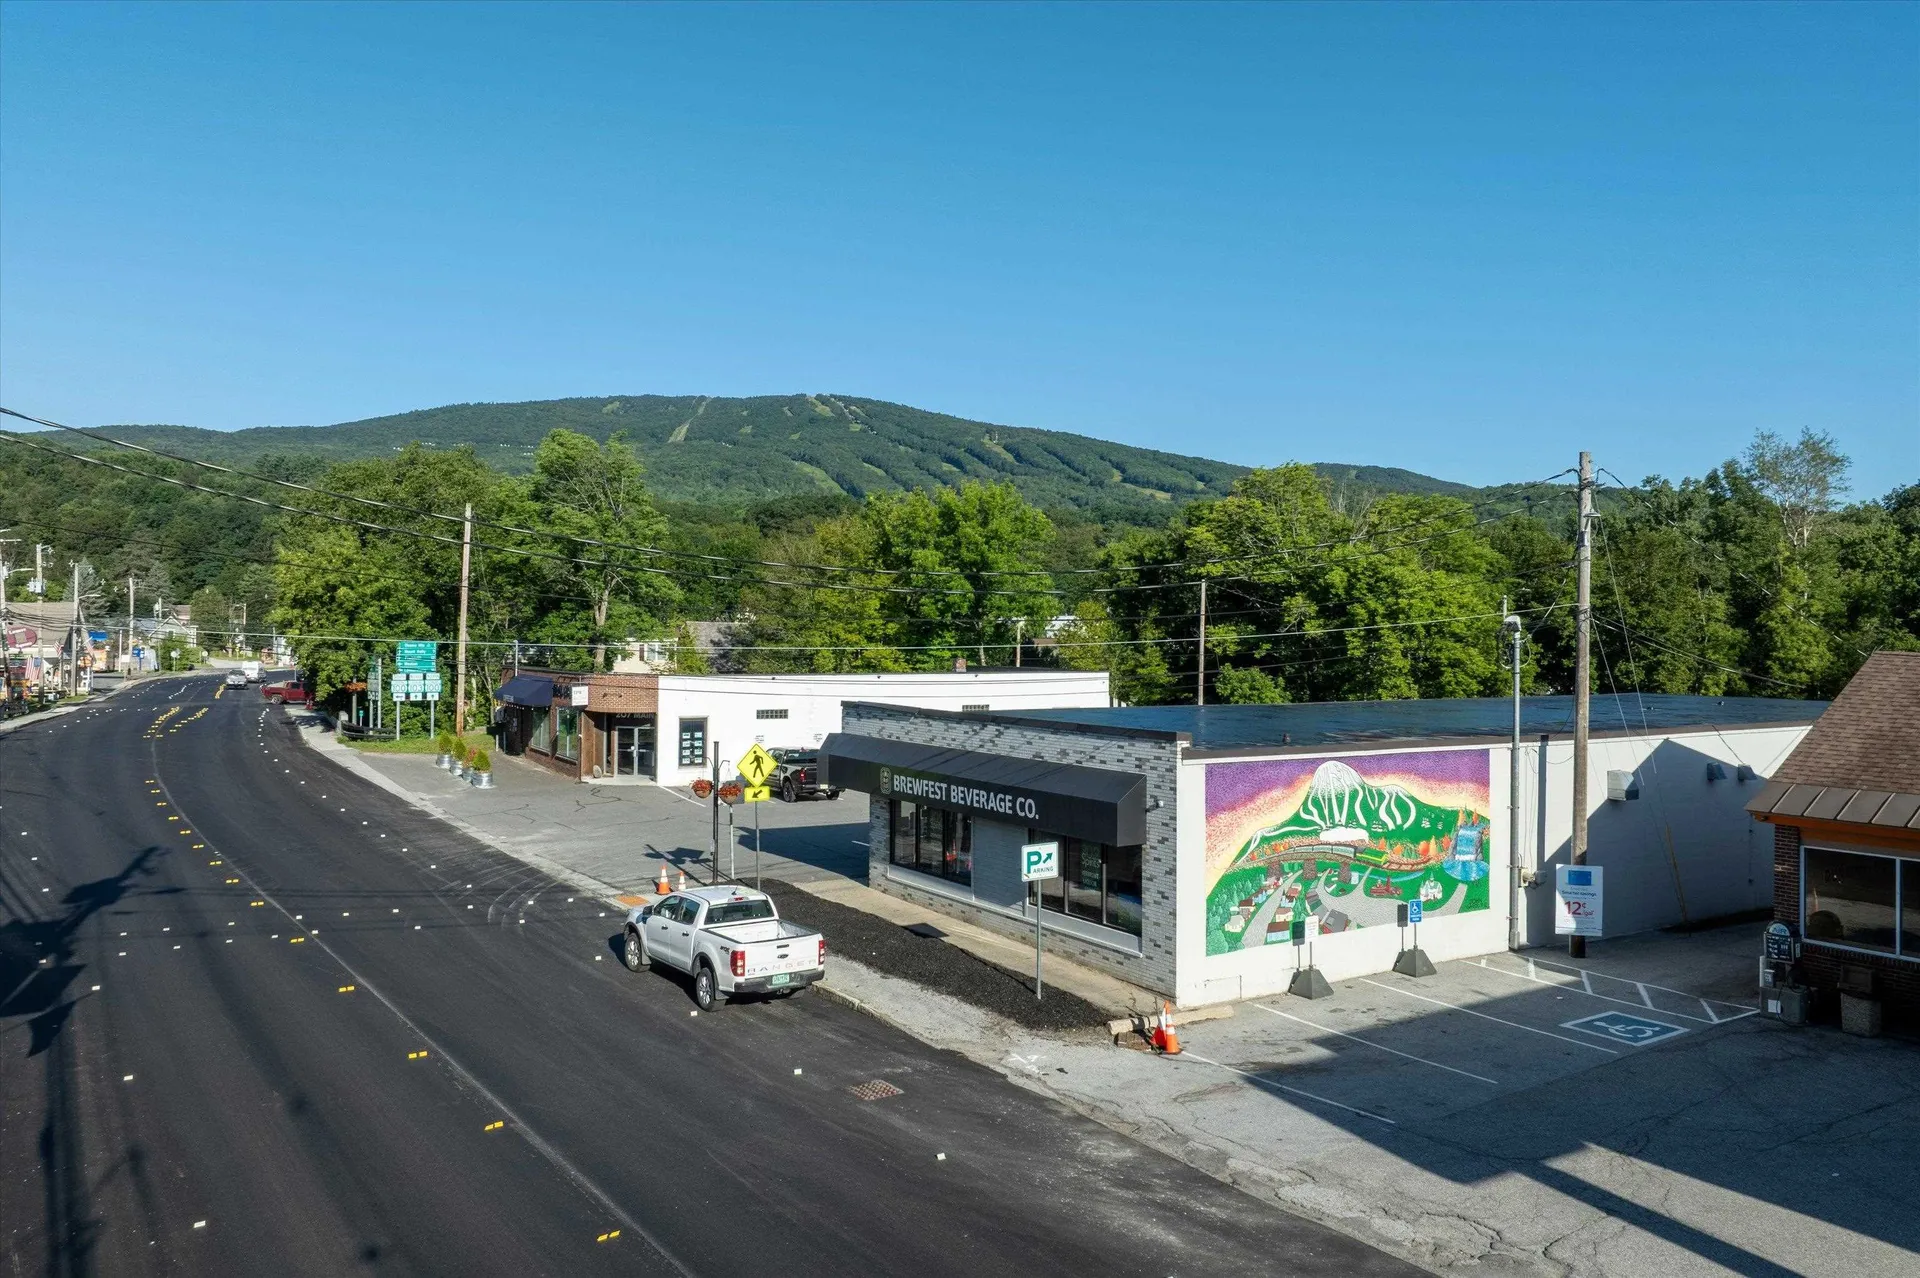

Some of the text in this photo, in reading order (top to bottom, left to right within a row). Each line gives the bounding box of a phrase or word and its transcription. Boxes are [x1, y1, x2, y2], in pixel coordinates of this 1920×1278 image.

[893, 774, 948, 801] BREWFEST
[950, 785, 1013, 815] BEVERAGE
[1016, 798, 1039, 820] CO.
[748, 960, 816, 973] RANGER
